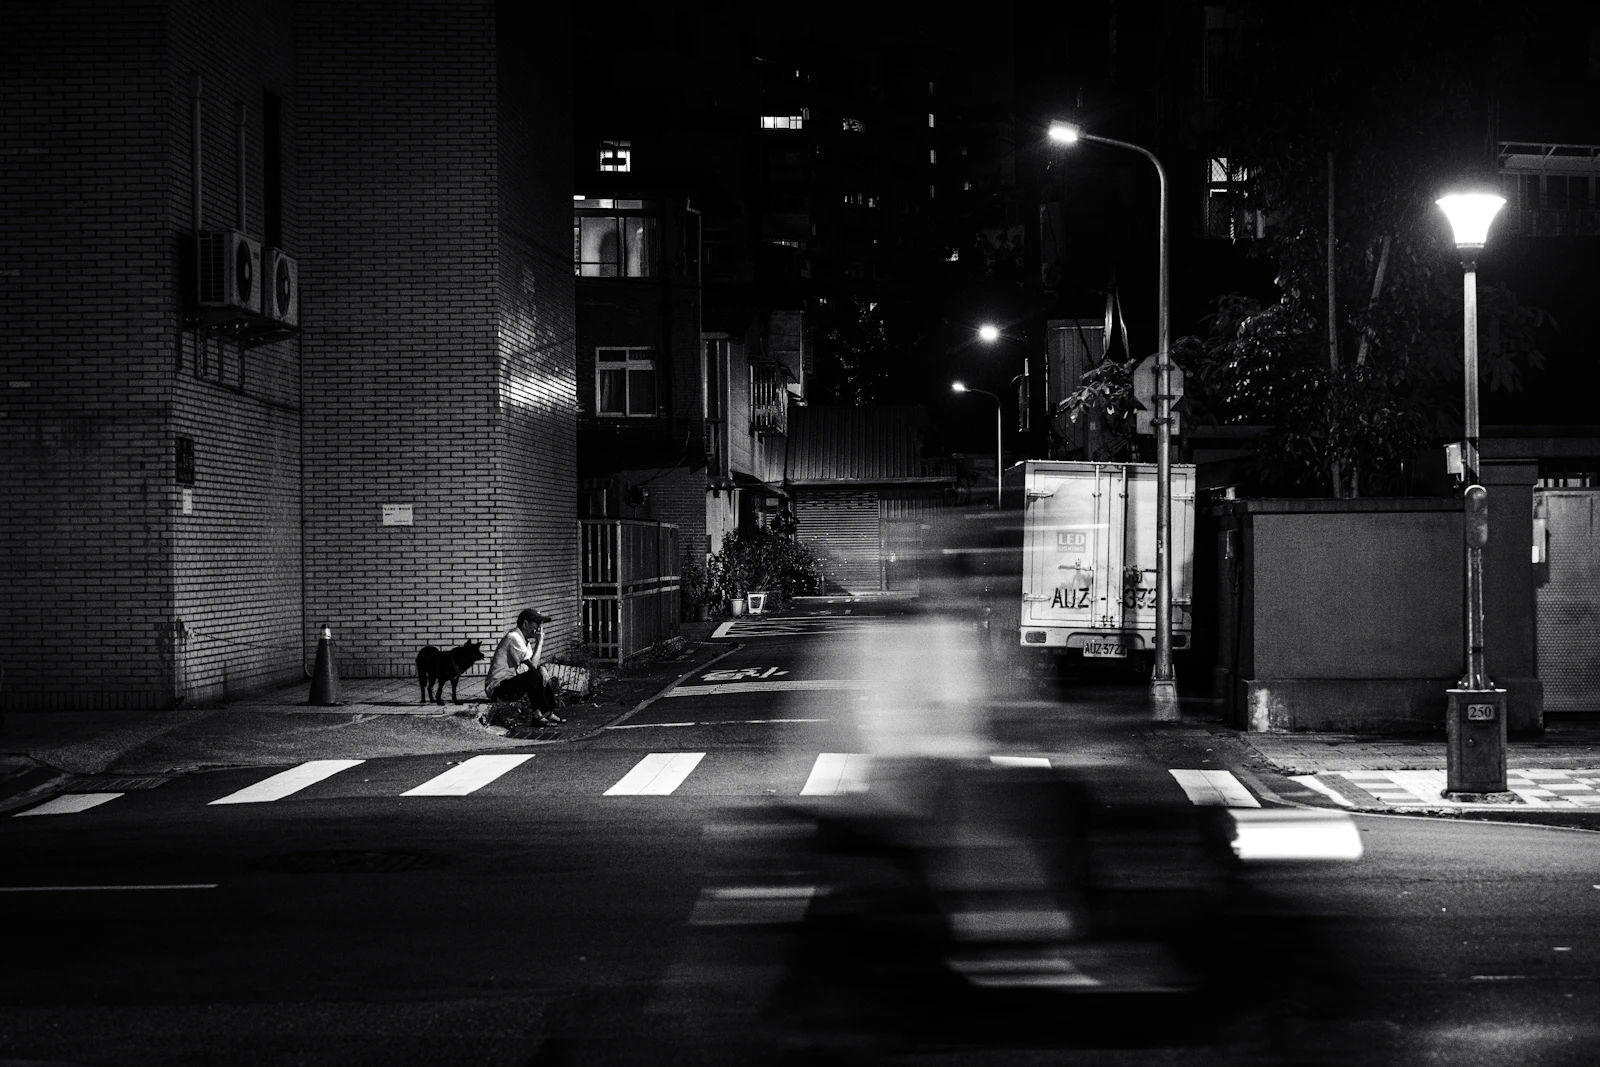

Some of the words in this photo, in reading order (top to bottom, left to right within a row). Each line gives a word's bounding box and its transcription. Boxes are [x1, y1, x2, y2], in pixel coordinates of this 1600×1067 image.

[1059, 534, 1085, 545] LED
[1051, 587, 1090, 609] AUZ
[1085, 642, 1126, 655] AUZ-3722
[1469, 706, 1492, 718] 250
